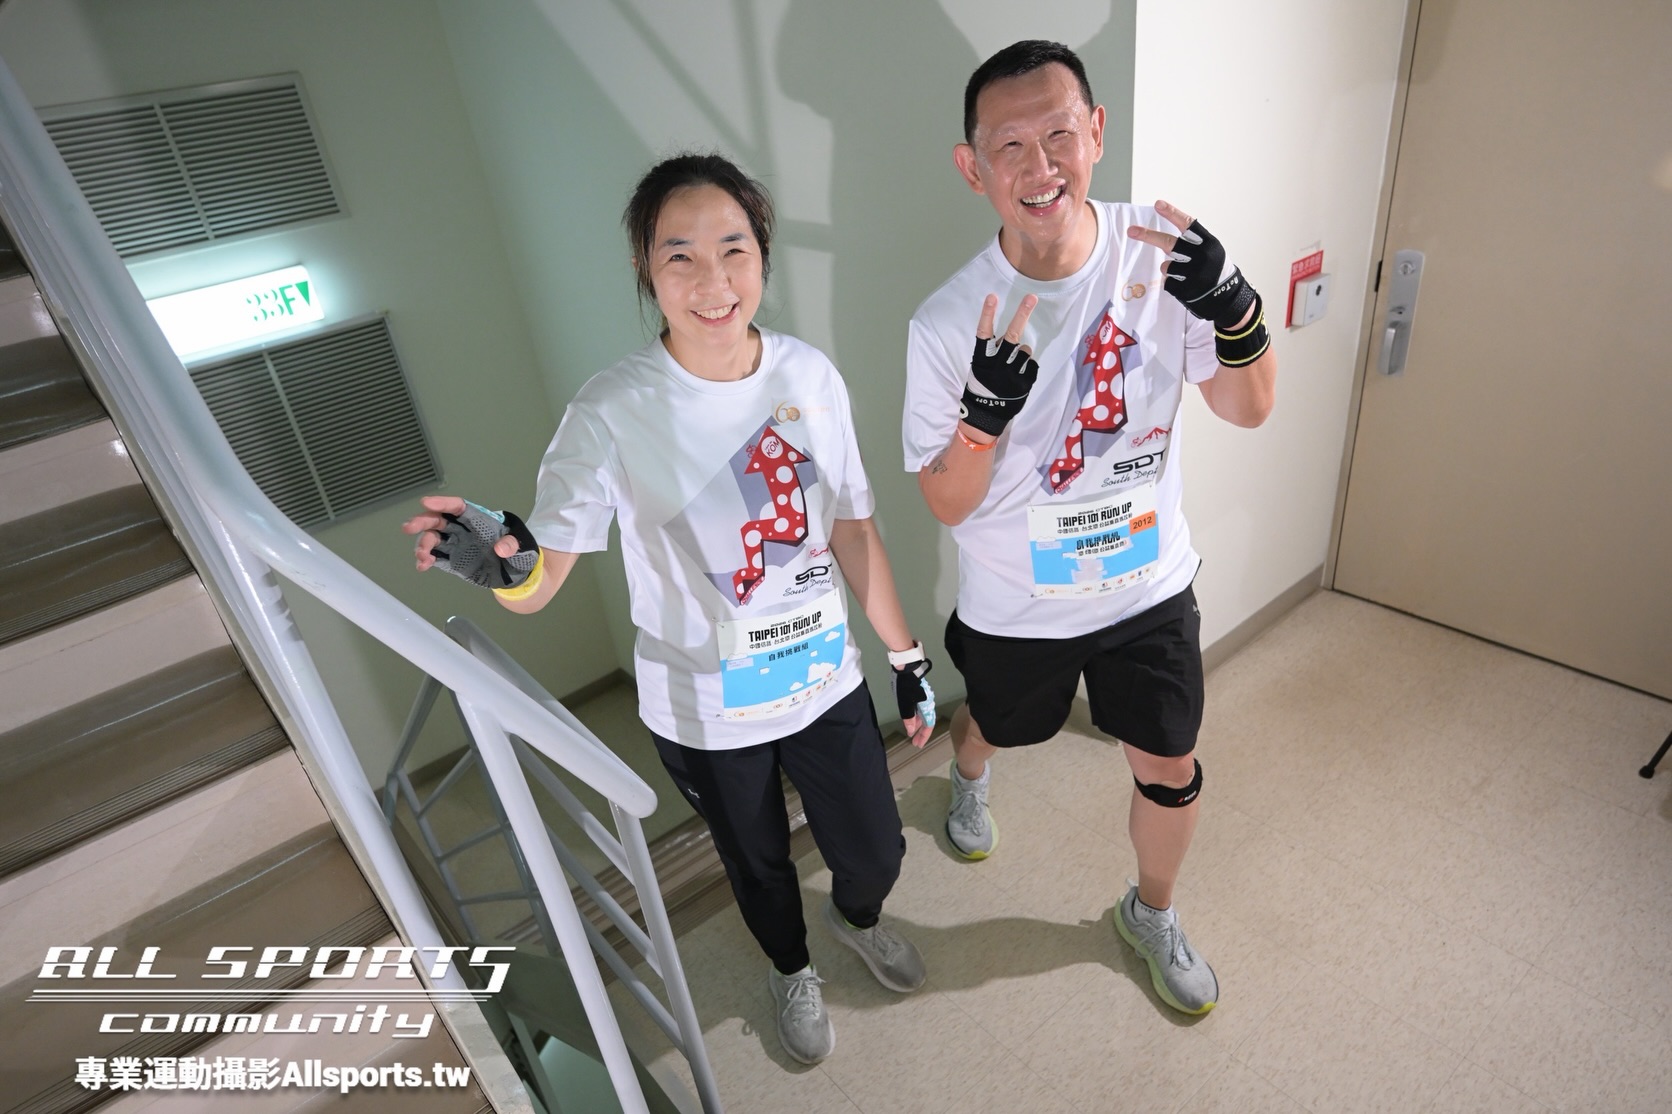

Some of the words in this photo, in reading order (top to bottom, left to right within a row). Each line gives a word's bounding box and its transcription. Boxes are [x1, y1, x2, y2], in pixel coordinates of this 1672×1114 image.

[1101, 473, 1131, 488] South
[1056, 512, 1086, 528] TAIPEI
[1087, 512, 1099, 524] 101
[1101, 507, 1120, 521] RUN
[1121, 501, 1132, 514] UP
[1133, 516, 1152, 530] 2012
[795, 562, 833, 586] SD
[783, 583, 808, 597] South
[748, 627, 778, 642] TAIPEI
[780, 624, 791, 636] 101
[793, 616, 810, 632] RUN
[812, 610, 822, 624] UP
